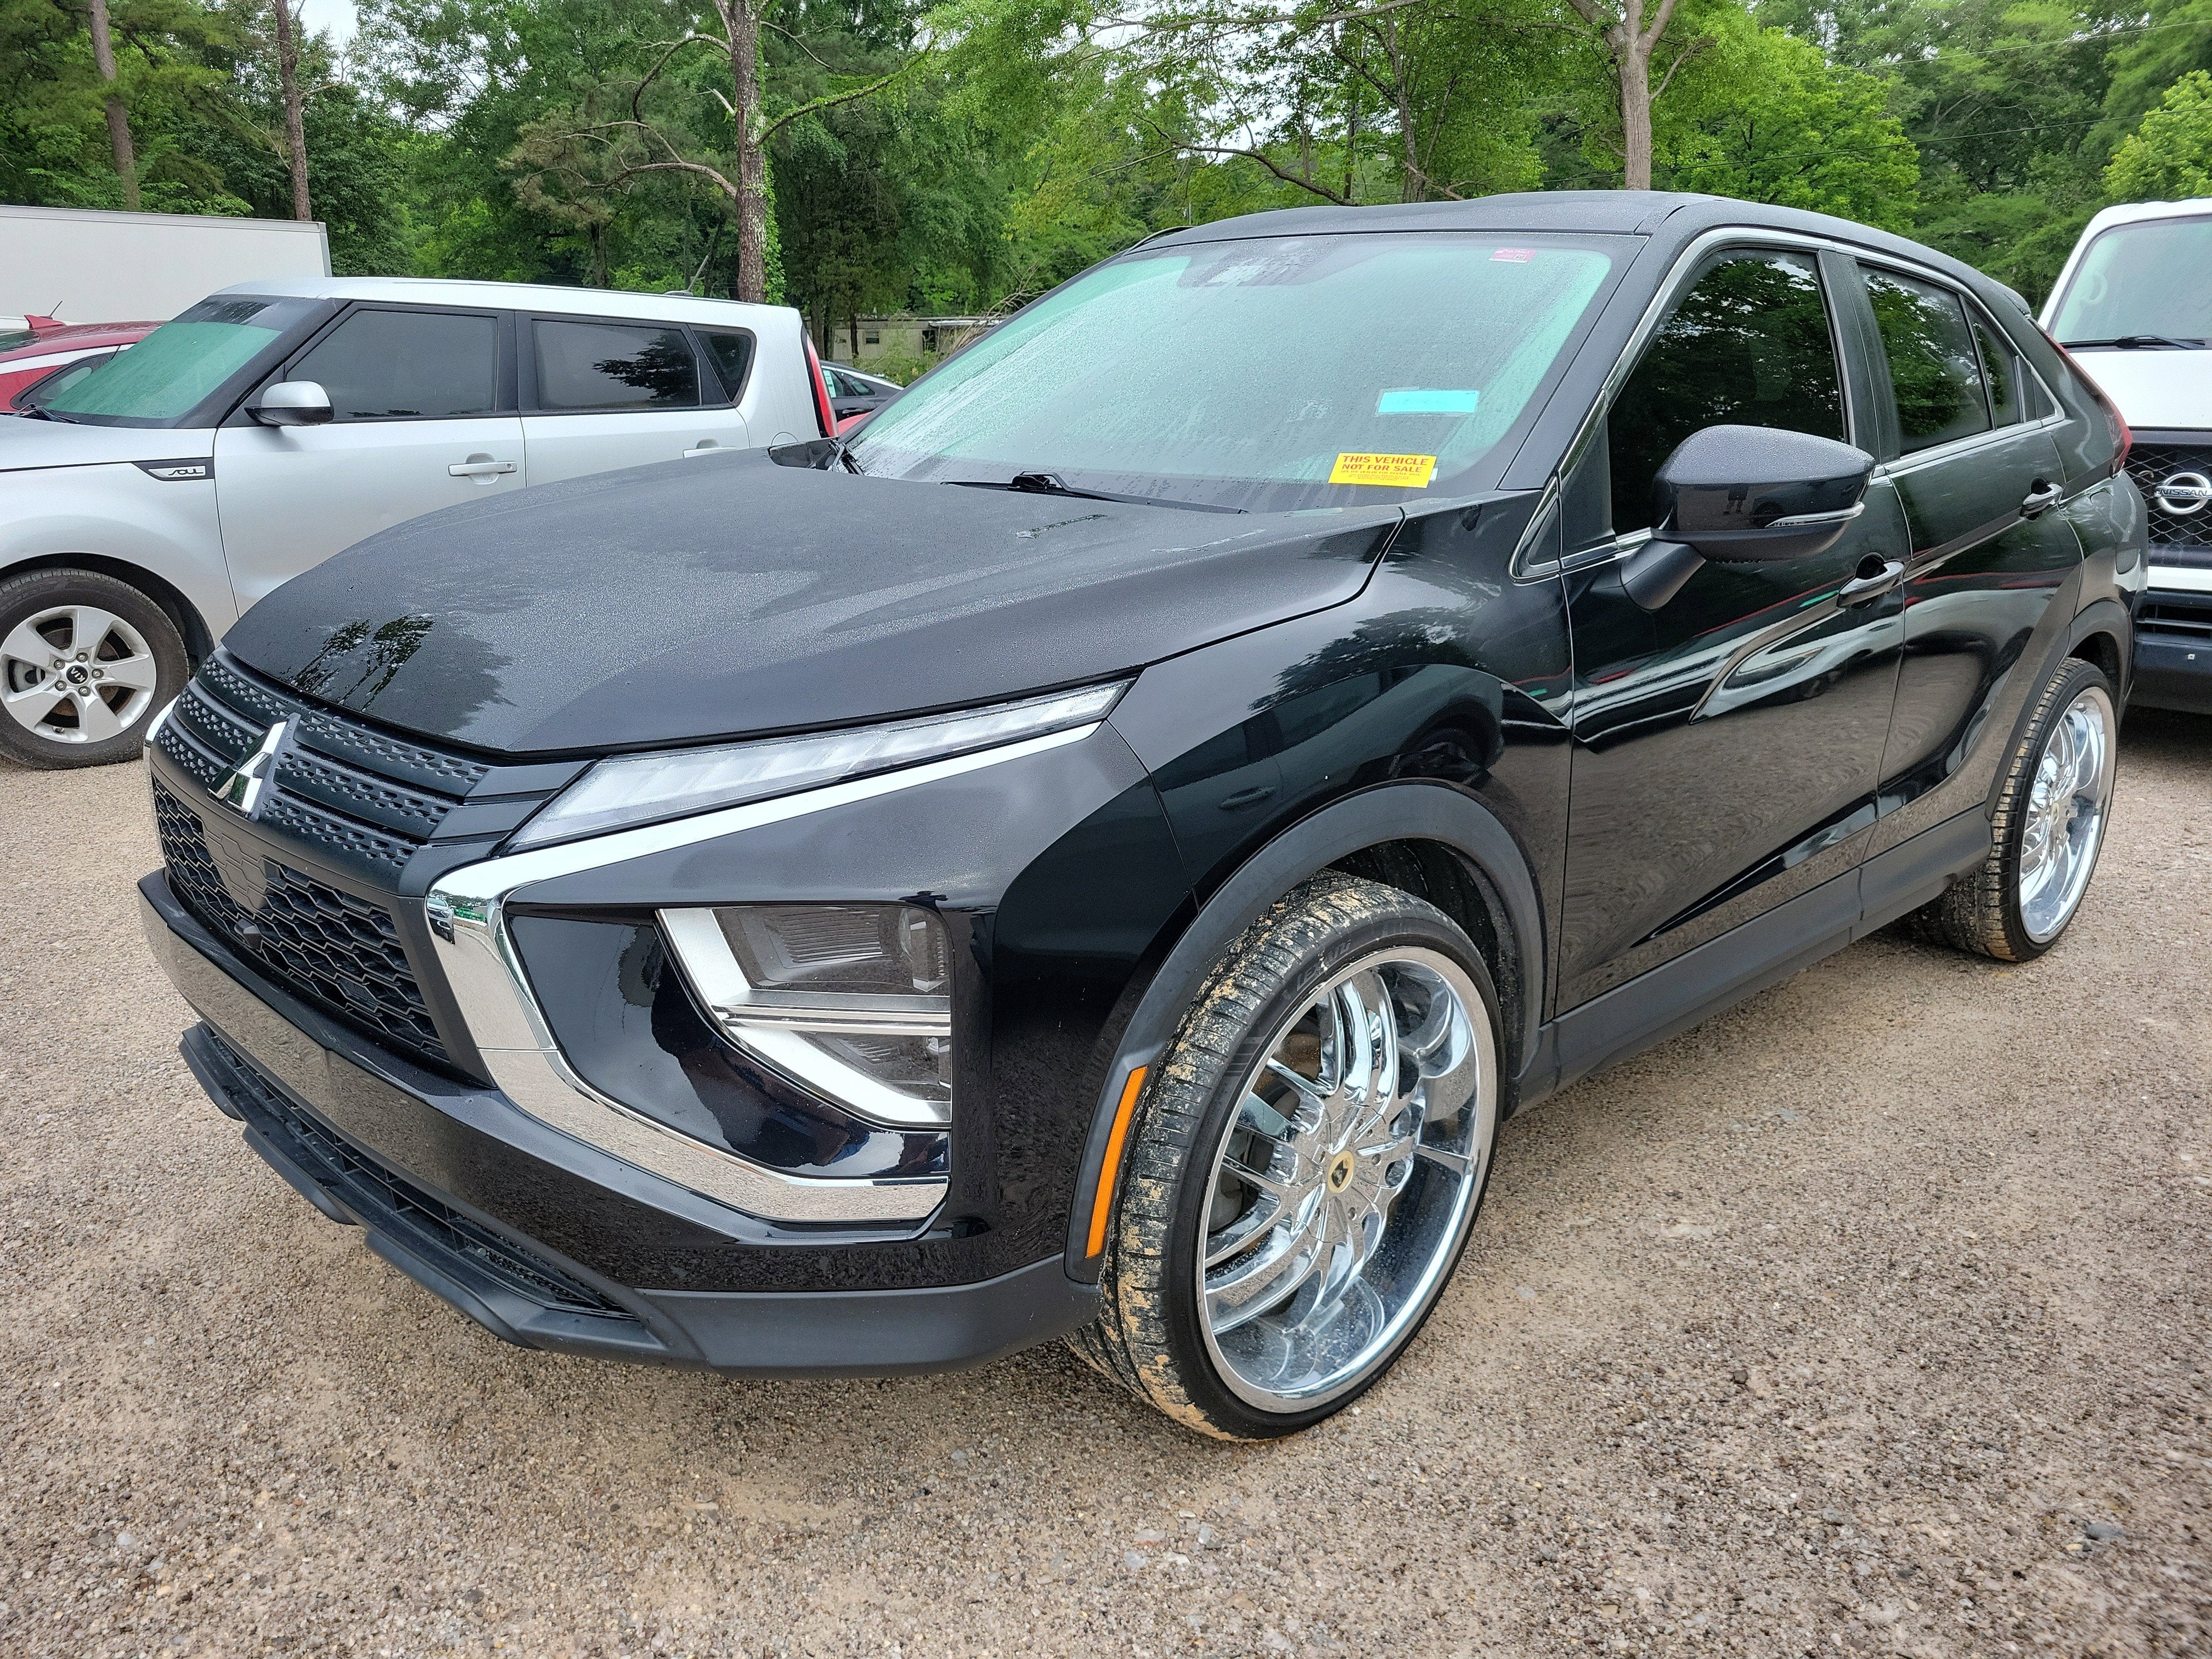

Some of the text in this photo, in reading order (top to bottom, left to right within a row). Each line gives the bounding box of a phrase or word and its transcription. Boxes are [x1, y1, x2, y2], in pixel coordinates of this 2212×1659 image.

[1375, 456, 1429, 465] VEHICLE
[2160, 488, 2207, 496] NISSAN
[71, 668, 86, 682] KIA
